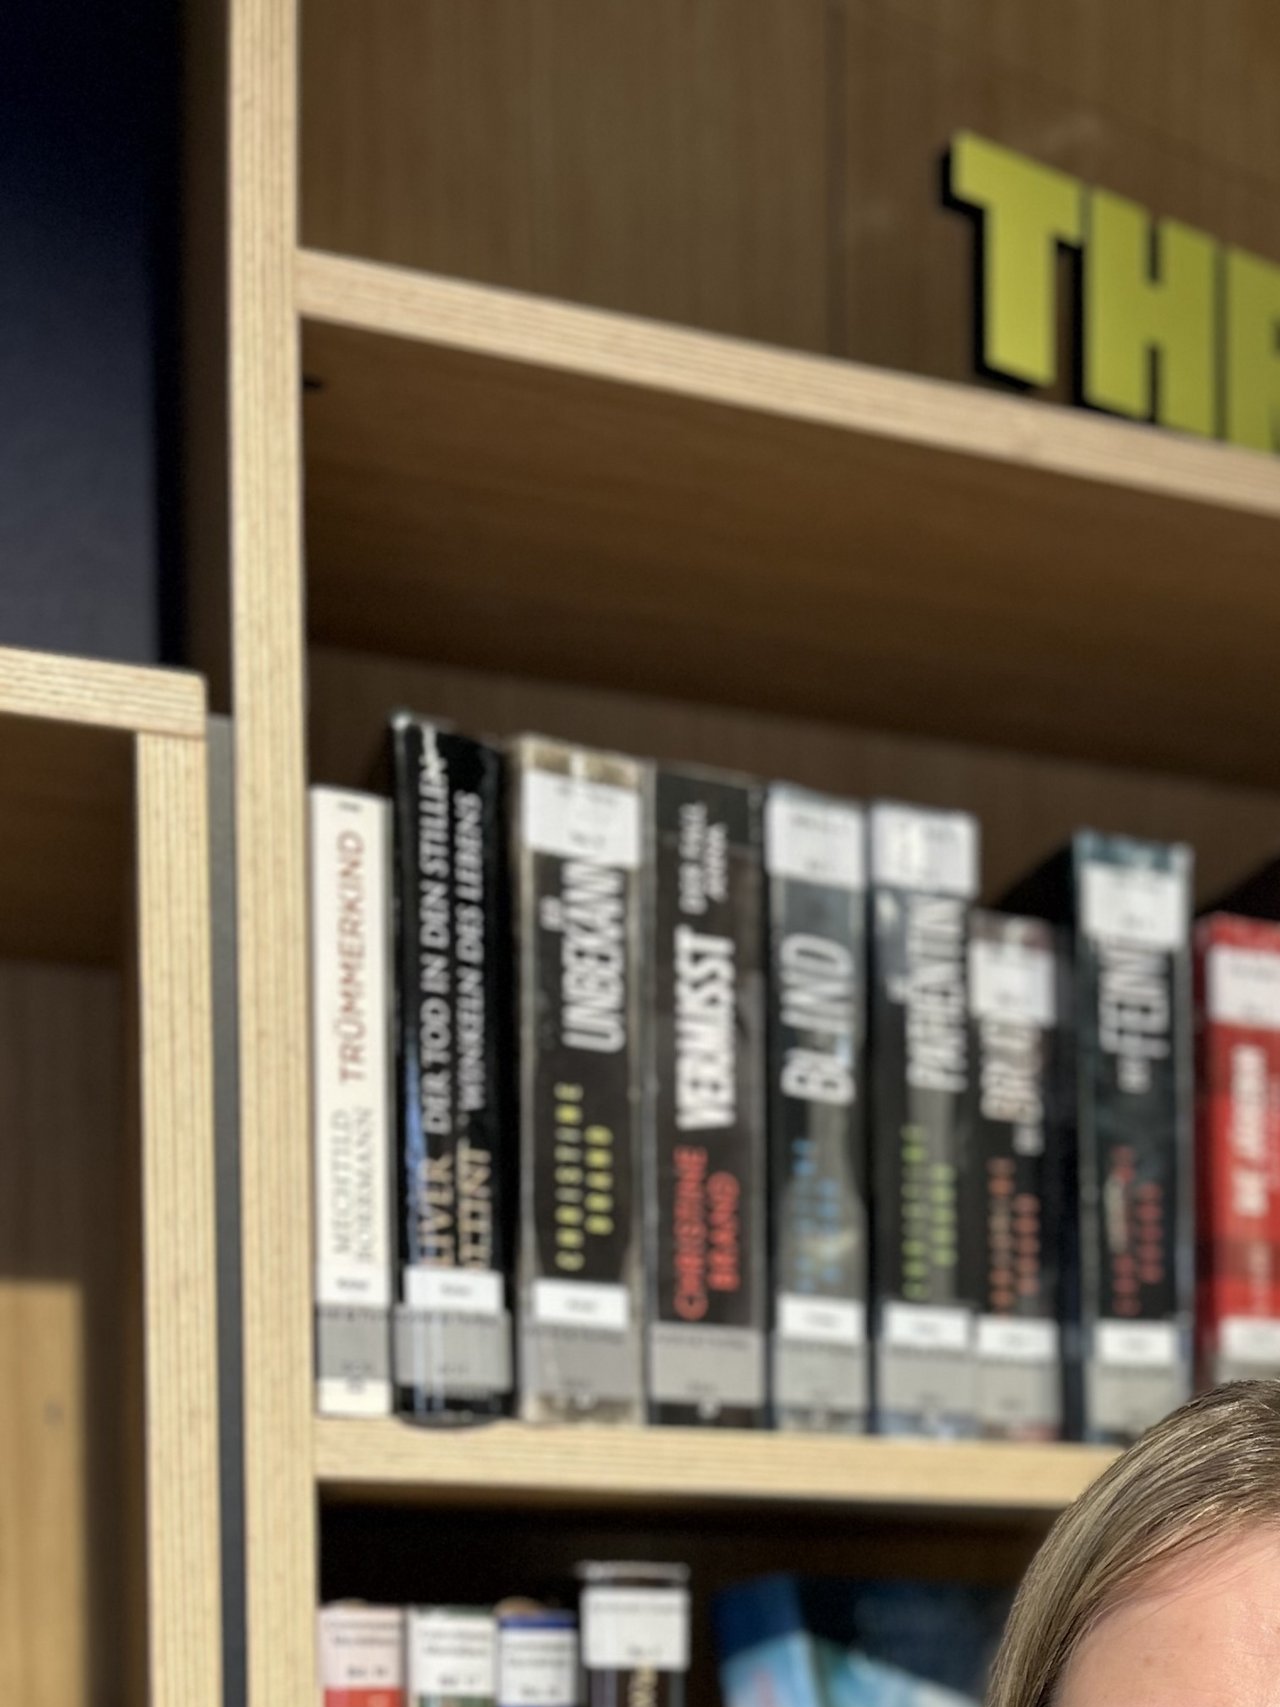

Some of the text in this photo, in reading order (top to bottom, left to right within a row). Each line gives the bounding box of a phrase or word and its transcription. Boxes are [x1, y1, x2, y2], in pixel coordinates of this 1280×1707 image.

[336, 830, 366, 1083] TRÜMMERKIND
[421, 881, 449, 948] DEN
[421, 955, 449, 993] IN
[454, 792, 486, 1110] WINKELN DES LEBENS
[560, 862, 626, 1052] UNBEKANN
[422, 1001, 449, 1064] TOD
[675, 925, 736, 1131] VERMISST
[782, 934, 856, 1105] BLIND
[1100, 940, 1170, 1058] FEIN
[424, 1069, 451, 1134] DER
[331, 1108, 353, 1255] MECHTILD
[417, 1155, 453, 1267] LIVER
[675, 1145, 707, 1319] CHRISTINE
[708, 1172, 740, 1291] BRAND
